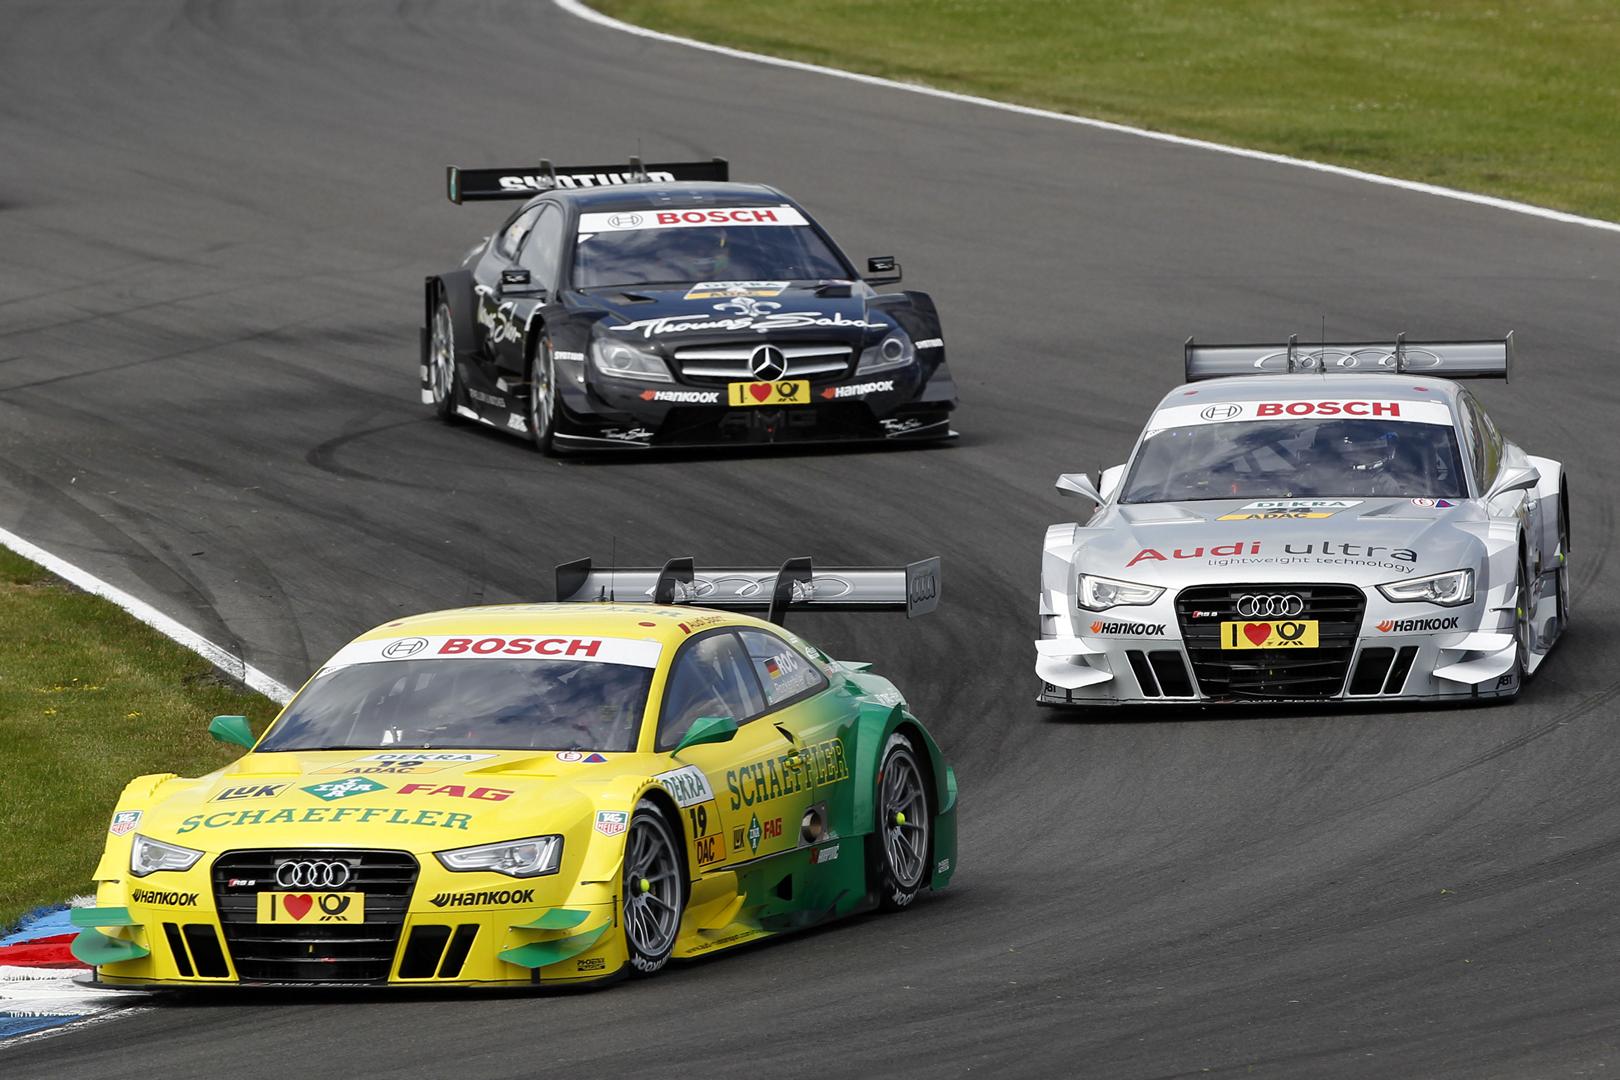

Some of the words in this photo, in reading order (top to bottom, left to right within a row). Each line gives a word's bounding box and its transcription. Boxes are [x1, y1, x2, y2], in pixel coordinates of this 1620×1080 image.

[656, 210, 778, 225] BOSCH
[609, 314, 752, 338] Thomas
[1256, 402, 1400, 418] BOSCH
[1125, 541, 1261, 568] Audi
[1284, 541, 1418, 563] ultra
[1208, 556, 1310, 567] lightweight
[1316, 557, 1416, 574] technology
[437, 638, 602, 657] BOSCH
[347, 766, 416, 774] ADAC
[379, 760, 424, 768] 19
[397, 783, 515, 801] FAG
[176, 807, 473, 834] SCHAEFFLER
[602, 812, 621, 823] TAG
[689, 805, 707, 838] 19
[598, 822, 624, 833] HEUER
[763, 817, 783, 840] FAG
